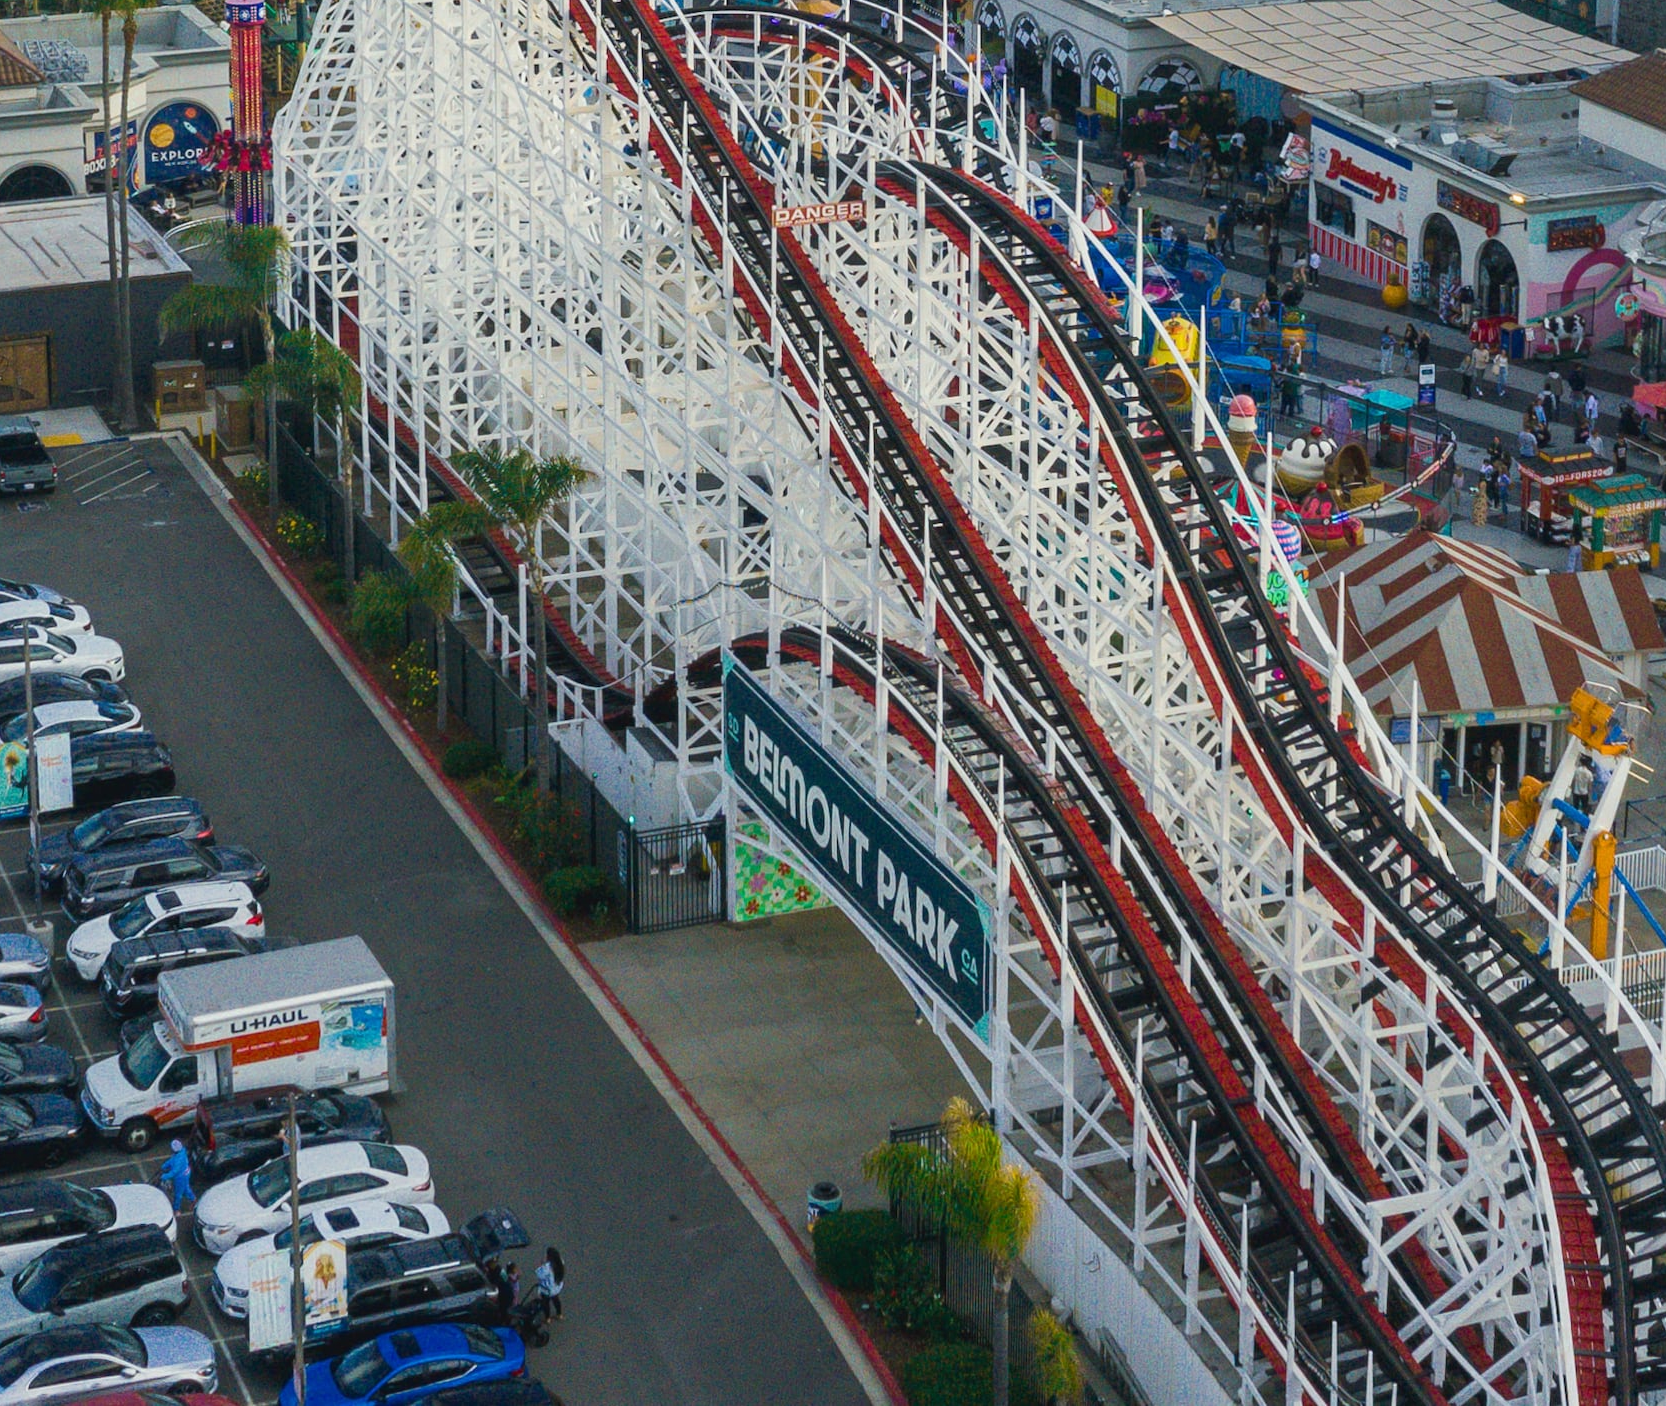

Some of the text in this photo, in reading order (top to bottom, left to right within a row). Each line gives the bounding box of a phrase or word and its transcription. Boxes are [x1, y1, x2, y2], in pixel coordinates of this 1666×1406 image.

[775, 202, 863, 222] DANGER
[744, 714, 959, 983] BELMONT PARK
[230, 1009, 309, 1034] U-HAUL
